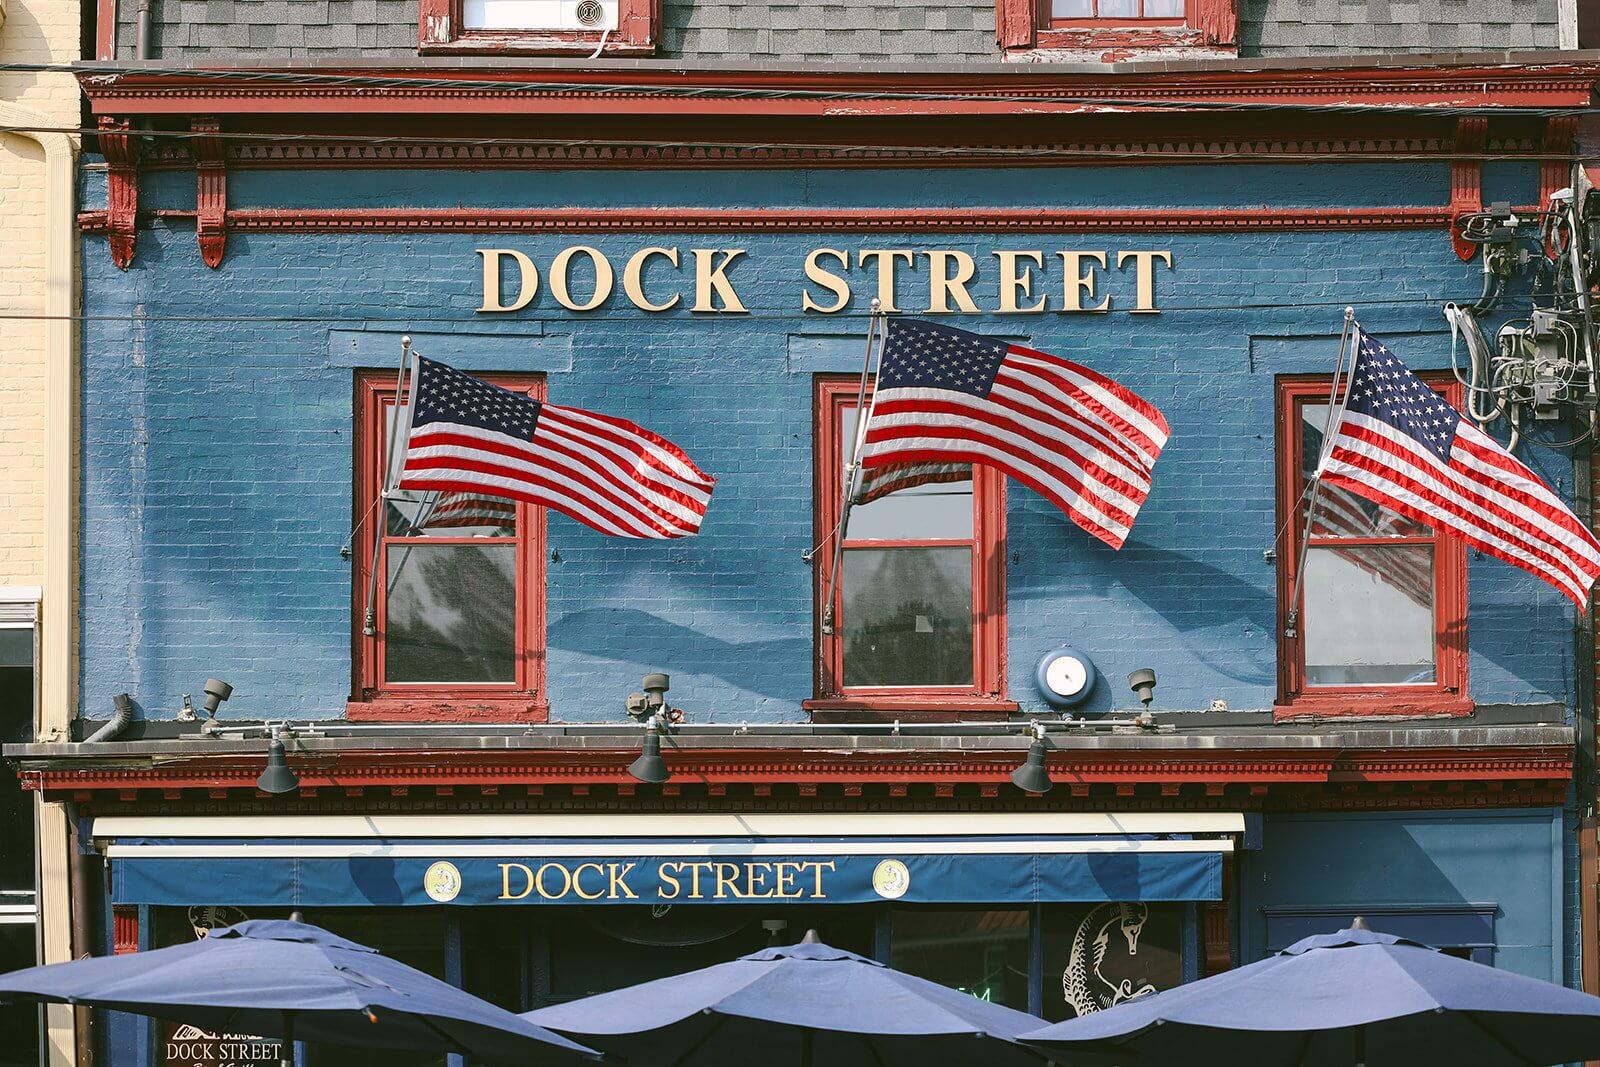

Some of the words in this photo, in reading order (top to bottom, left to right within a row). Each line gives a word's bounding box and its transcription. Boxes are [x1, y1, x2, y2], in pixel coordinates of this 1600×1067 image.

[475, 245, 749, 313] DOCK
[802, 247, 1174, 314] STREET
[497, 862, 639, 900] DOCK
[657, 860, 836, 900] STREET
[166, 1043, 215, 1060] DOCK
[219, 1043, 282, 1060] STREET
